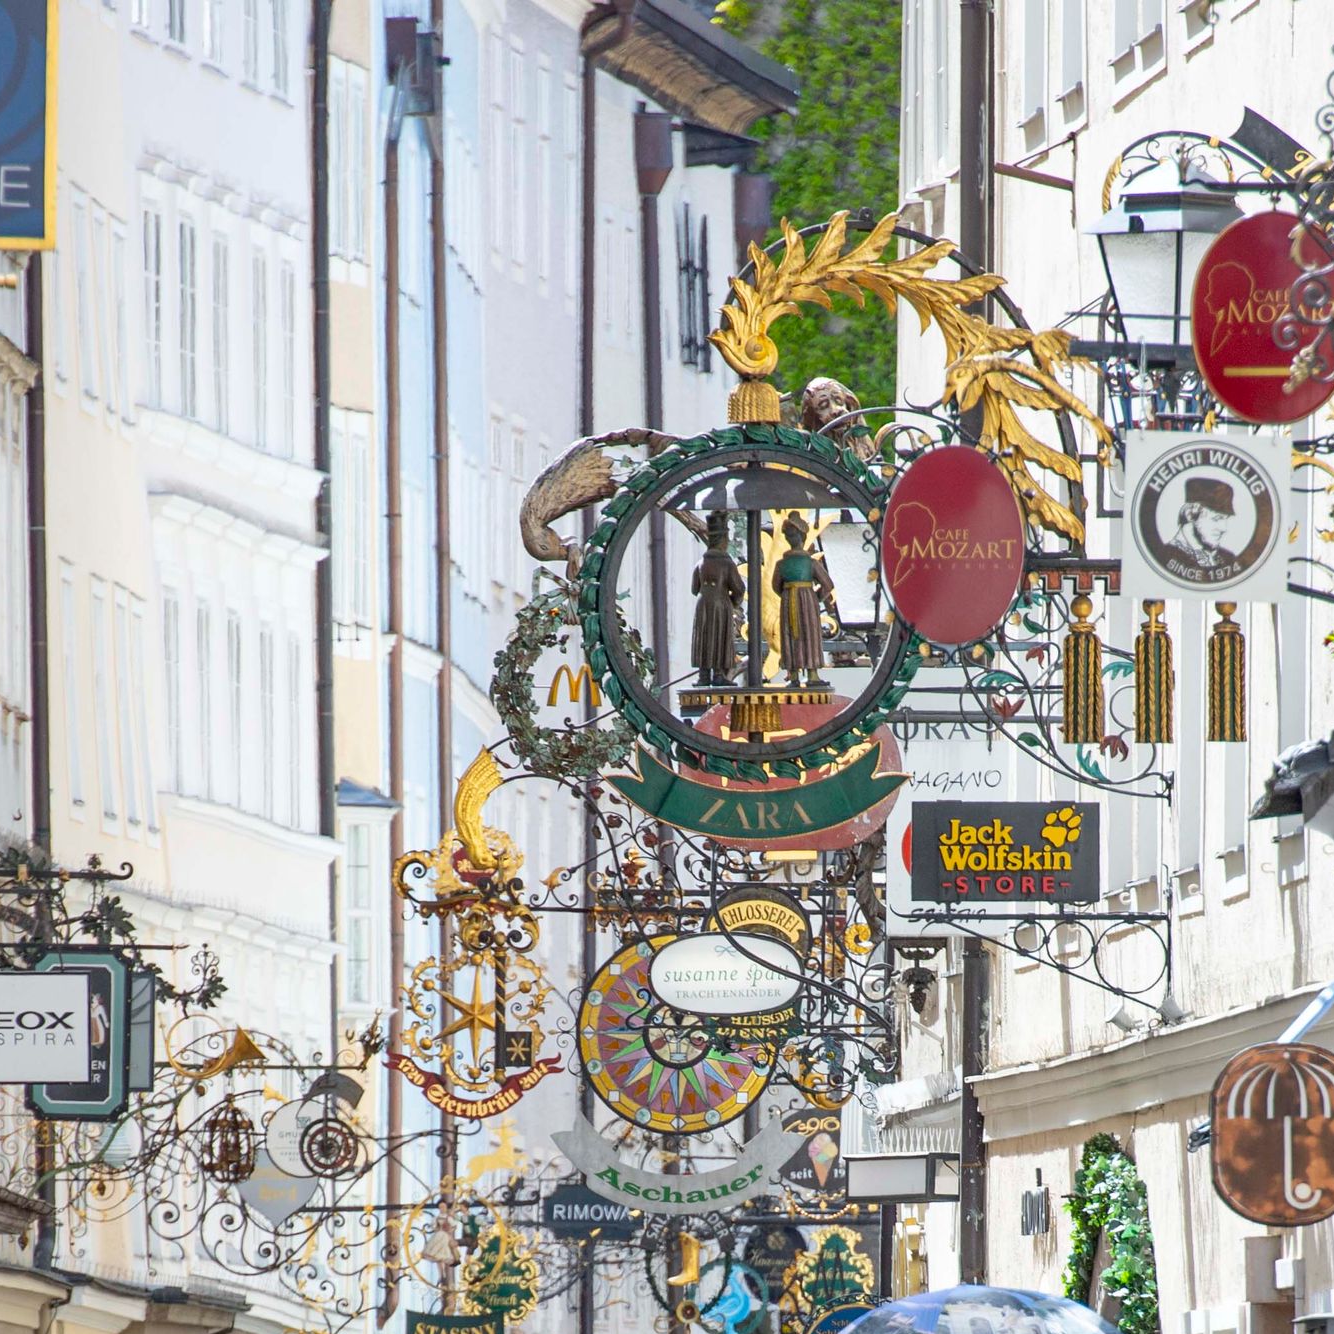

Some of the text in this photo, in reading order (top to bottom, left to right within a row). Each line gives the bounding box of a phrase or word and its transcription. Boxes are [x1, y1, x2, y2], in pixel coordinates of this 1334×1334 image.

[1149, 450, 1265, 496] HENRI WILLIG
[911, 537, 1016, 559] MOZART
[1167, 559, 1241, 580] SINCE 1974
[699, 799, 814, 831] ZARA
[938, 819, 1014, 845] Jack
[939, 845, 1072, 871] Wolfskin
[719, 903, 801, 933] CHLOSSEREI
[664, 969, 739, 983] susanne
[675, 988, 781, 1000] TRACHTENKINDER
[397, 1058, 426, 1086] 1720
[519, 1062, 550, 1091] 2014
[593, 1163, 764, 1204] Aschauer
[790, 1168, 813, 1179] seit
[553, 1203, 632, 1222] RIMOWA
